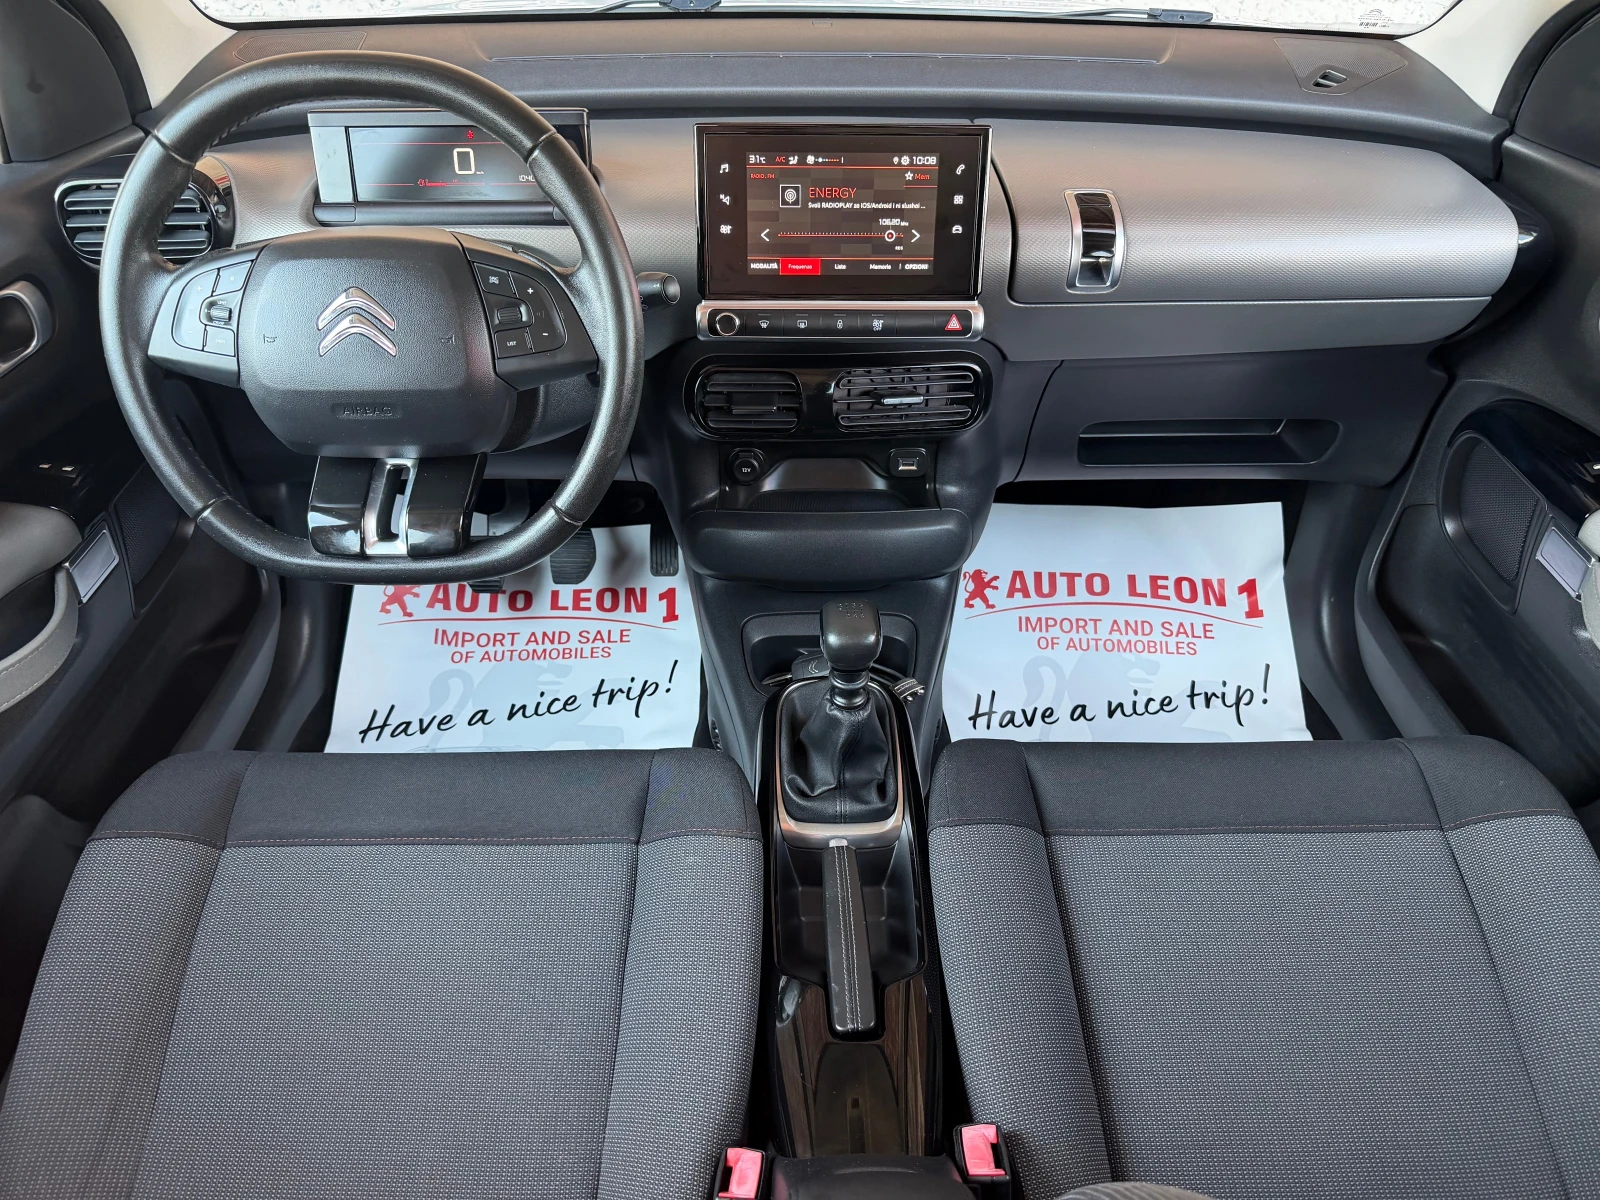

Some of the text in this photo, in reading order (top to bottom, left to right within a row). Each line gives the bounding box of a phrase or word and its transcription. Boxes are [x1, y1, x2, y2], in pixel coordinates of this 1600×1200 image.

[453, 148, 476, 175] 0
[912, 156, 937, 164] 10:08
[808, 186, 857, 199] ENERGY
[821, 201, 853, 209] RADIOPLAY
[549, 586, 648, 613] LEON
[657, 587, 680, 624] 1
[1005, 570, 1265, 620] AUTO LEON 1
[433, 628, 632, 648] IMPORT AND SALE
[1017, 616, 1216, 640] IMPORT AND SALE
[450, 646, 613, 664] OF AUTOMOBILES
[1036, 636, 1198, 656] OF AUTOMOBILES
[358, 659, 680, 744] Have a nice trip!
[968, 663, 1271, 731] Have a nice trip!
